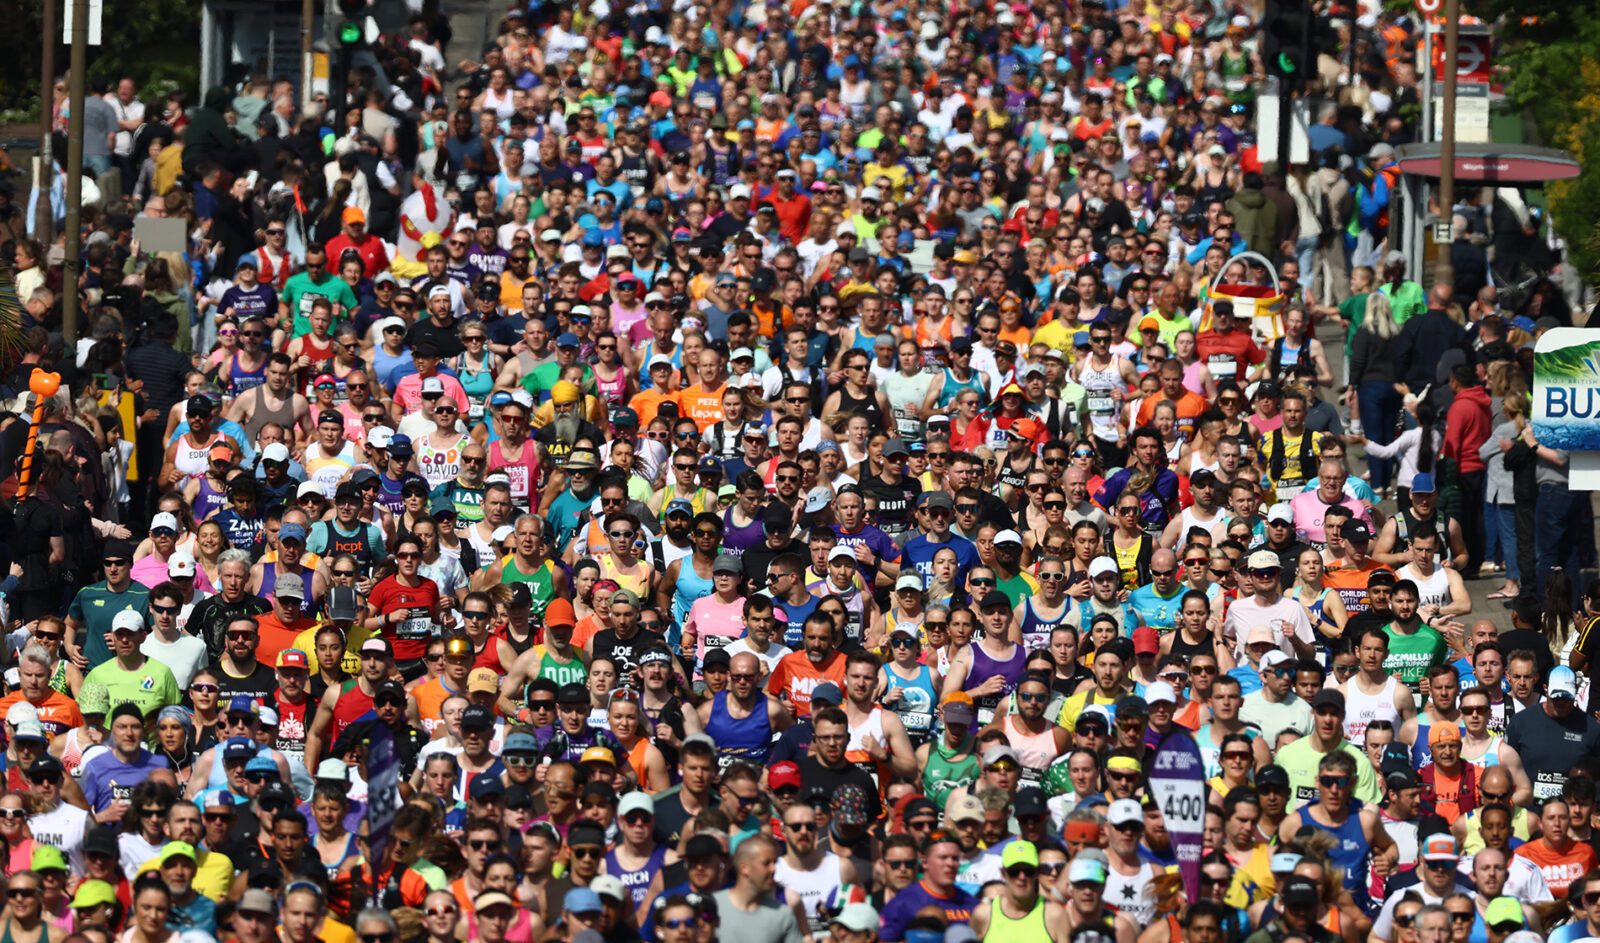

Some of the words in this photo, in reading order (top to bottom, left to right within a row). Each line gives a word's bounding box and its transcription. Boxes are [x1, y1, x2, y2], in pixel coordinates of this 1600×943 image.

[697, 398, 719, 406] PETE
[426, 463, 459, 476] DAVID
[880, 500, 906, 510] GEOFF
[229, 519, 264, 530] ZAIN
[336, 542, 363, 555] hcpt
[401, 620, 427, 630] 60790
[706, 637, 719, 646] tcs
[612, 646, 632, 656] JOE
[276, 739, 290, 750] tcs
[1538, 772, 1552, 782] tcs
[1299, 788, 1313, 798] tcs
[1165, 795, 1201, 820] 4:00
[621, 872, 649, 885] RICH
